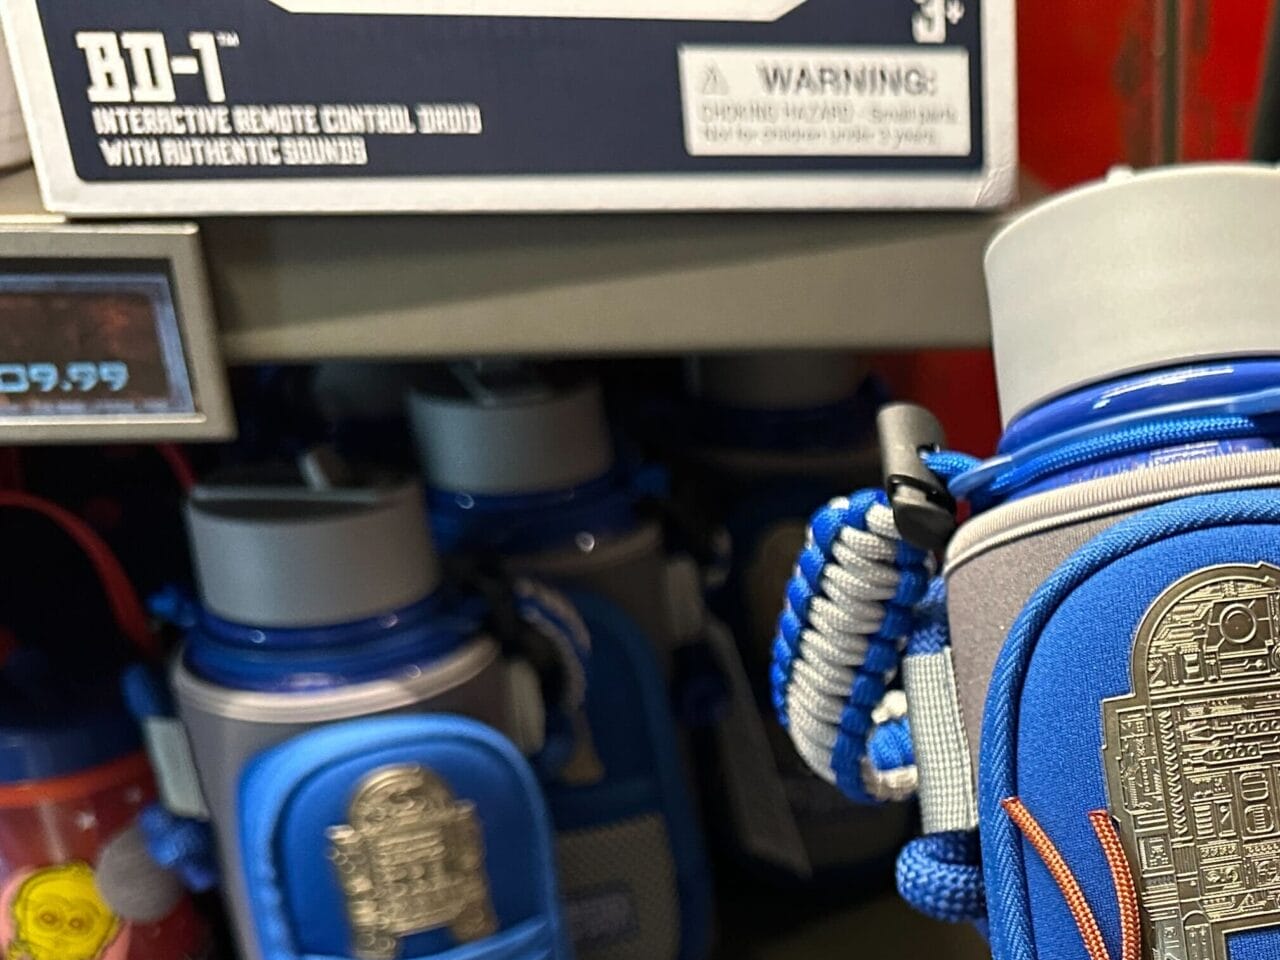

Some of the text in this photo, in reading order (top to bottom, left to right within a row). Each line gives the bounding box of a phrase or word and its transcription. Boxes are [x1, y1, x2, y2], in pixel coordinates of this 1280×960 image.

[758, 64, 938, 96] WARNING:
[91, 103, 483, 135] INTERACTIVE REMOTE CONTROL DROID
[99, 134, 368, 167] WITH AUTHENTIC SOUNDS
